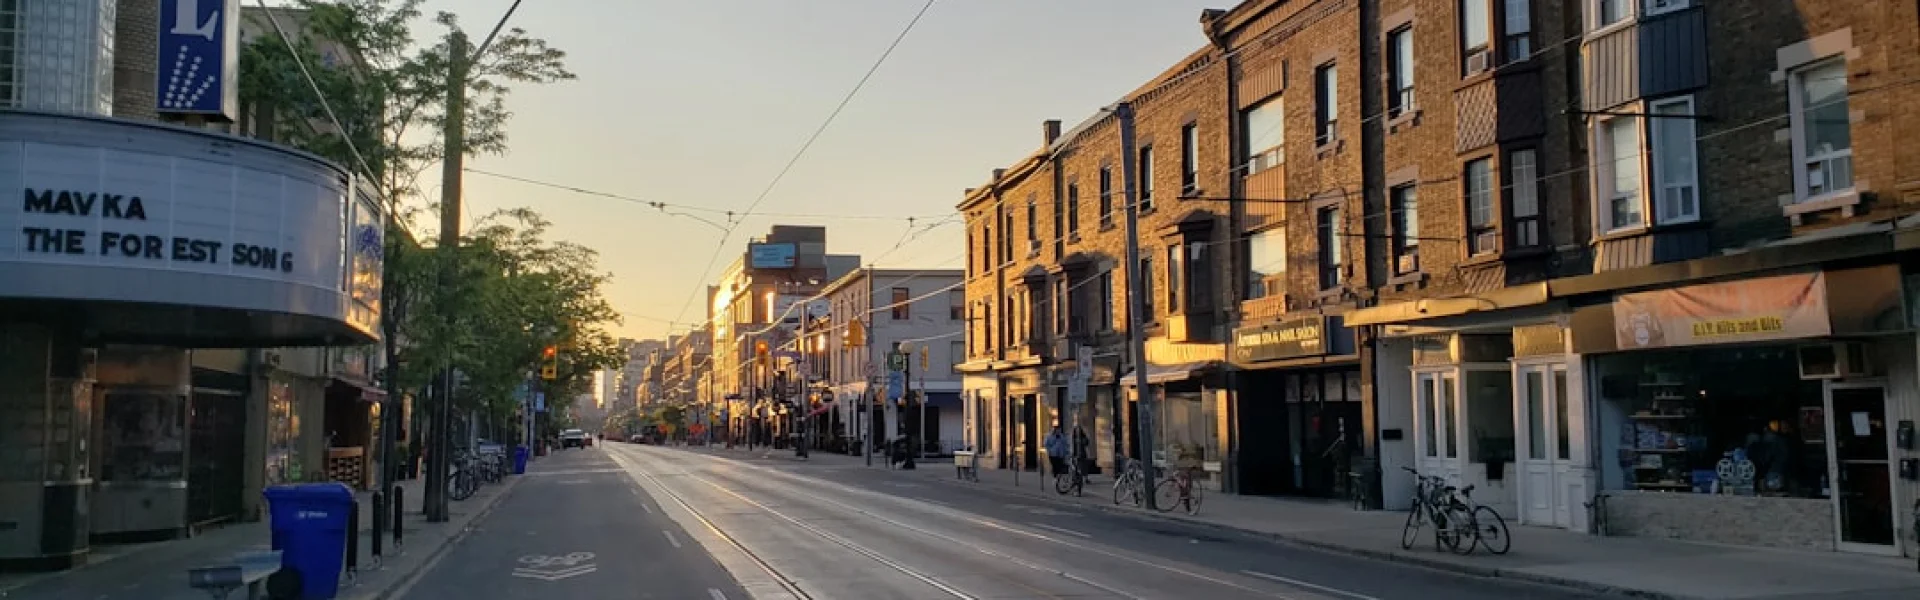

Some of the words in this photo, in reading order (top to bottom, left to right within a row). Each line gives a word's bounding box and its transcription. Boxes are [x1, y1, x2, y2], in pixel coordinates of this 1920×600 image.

[24, 188, 146, 220] MAVKA
[23, 227, 86, 254] THE
[101, 232, 222, 264] FOREST
[232, 242, 293, 273] SONG
